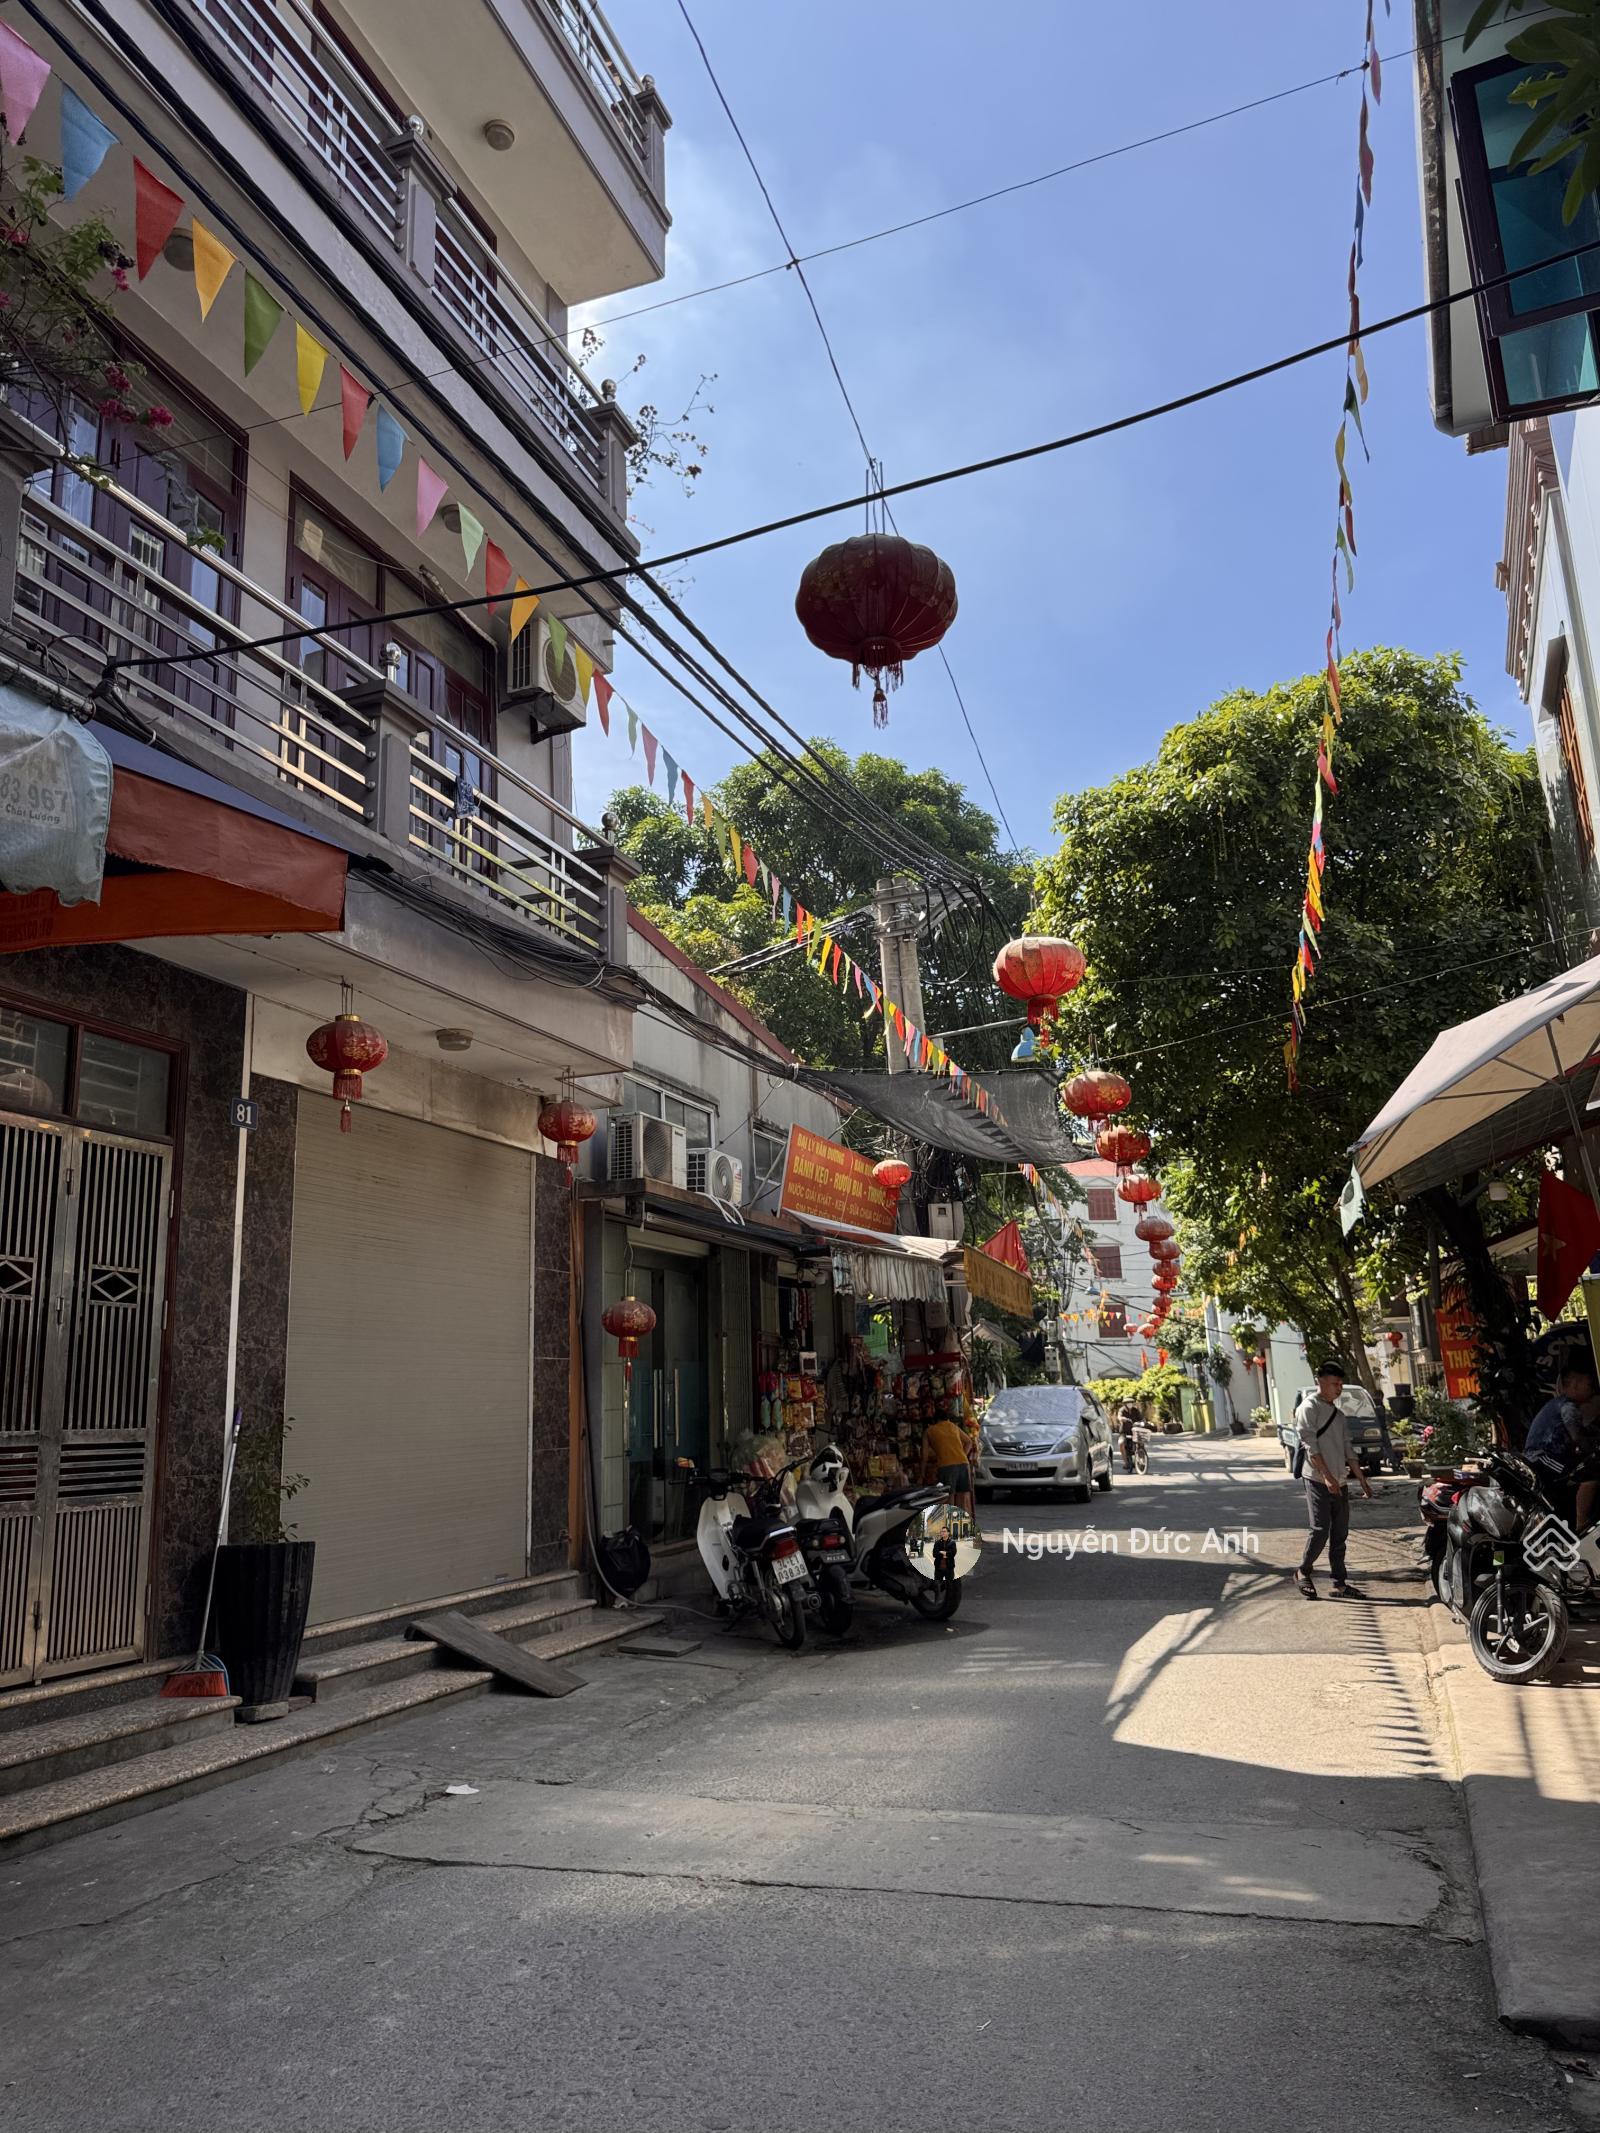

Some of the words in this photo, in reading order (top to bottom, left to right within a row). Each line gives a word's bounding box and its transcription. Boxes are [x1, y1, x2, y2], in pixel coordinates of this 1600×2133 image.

[236, 1103, 252, 1125] 81
[793, 1154, 815, 1180] BÁNH
[815, 1161, 829, 1187] KẸO
[851, 1179, 863, 1198] BIA
